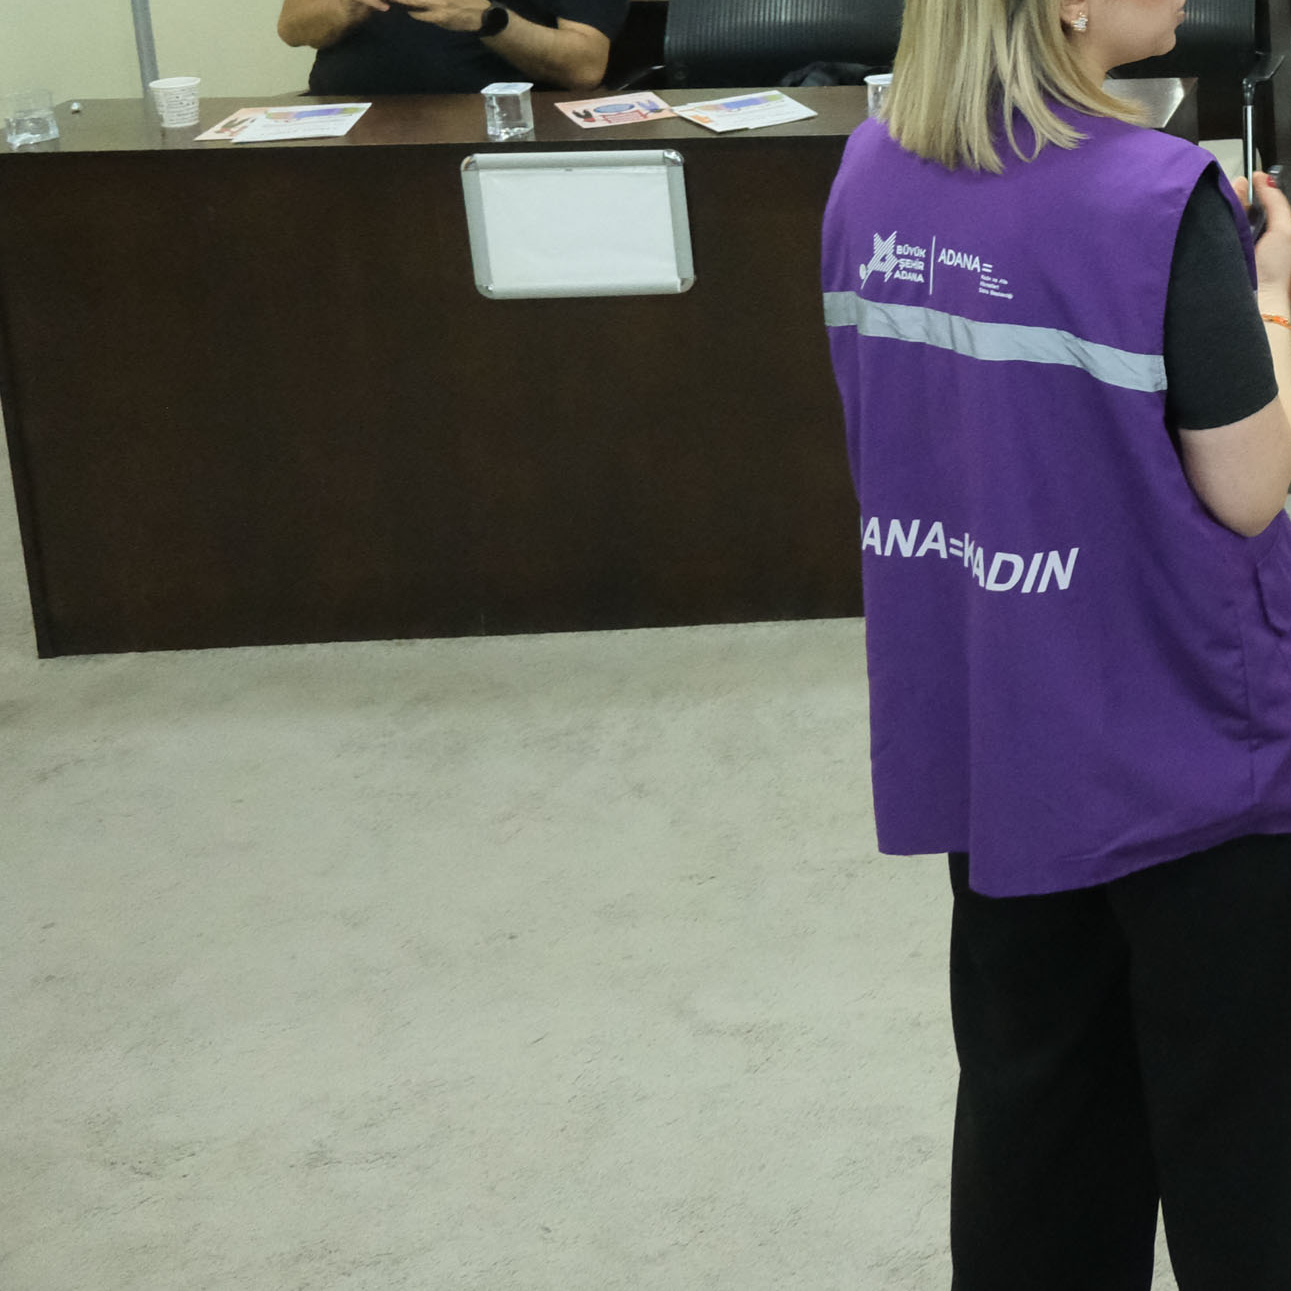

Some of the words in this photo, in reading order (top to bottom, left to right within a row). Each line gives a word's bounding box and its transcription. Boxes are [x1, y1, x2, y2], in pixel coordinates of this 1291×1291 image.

[896, 244, 927, 259] BÜYÜK
[898, 258, 925, 271] ŞEHİR
[893, 270, 925, 283] ADANA
[860, 516, 1080, 593] ANA=KADIN
